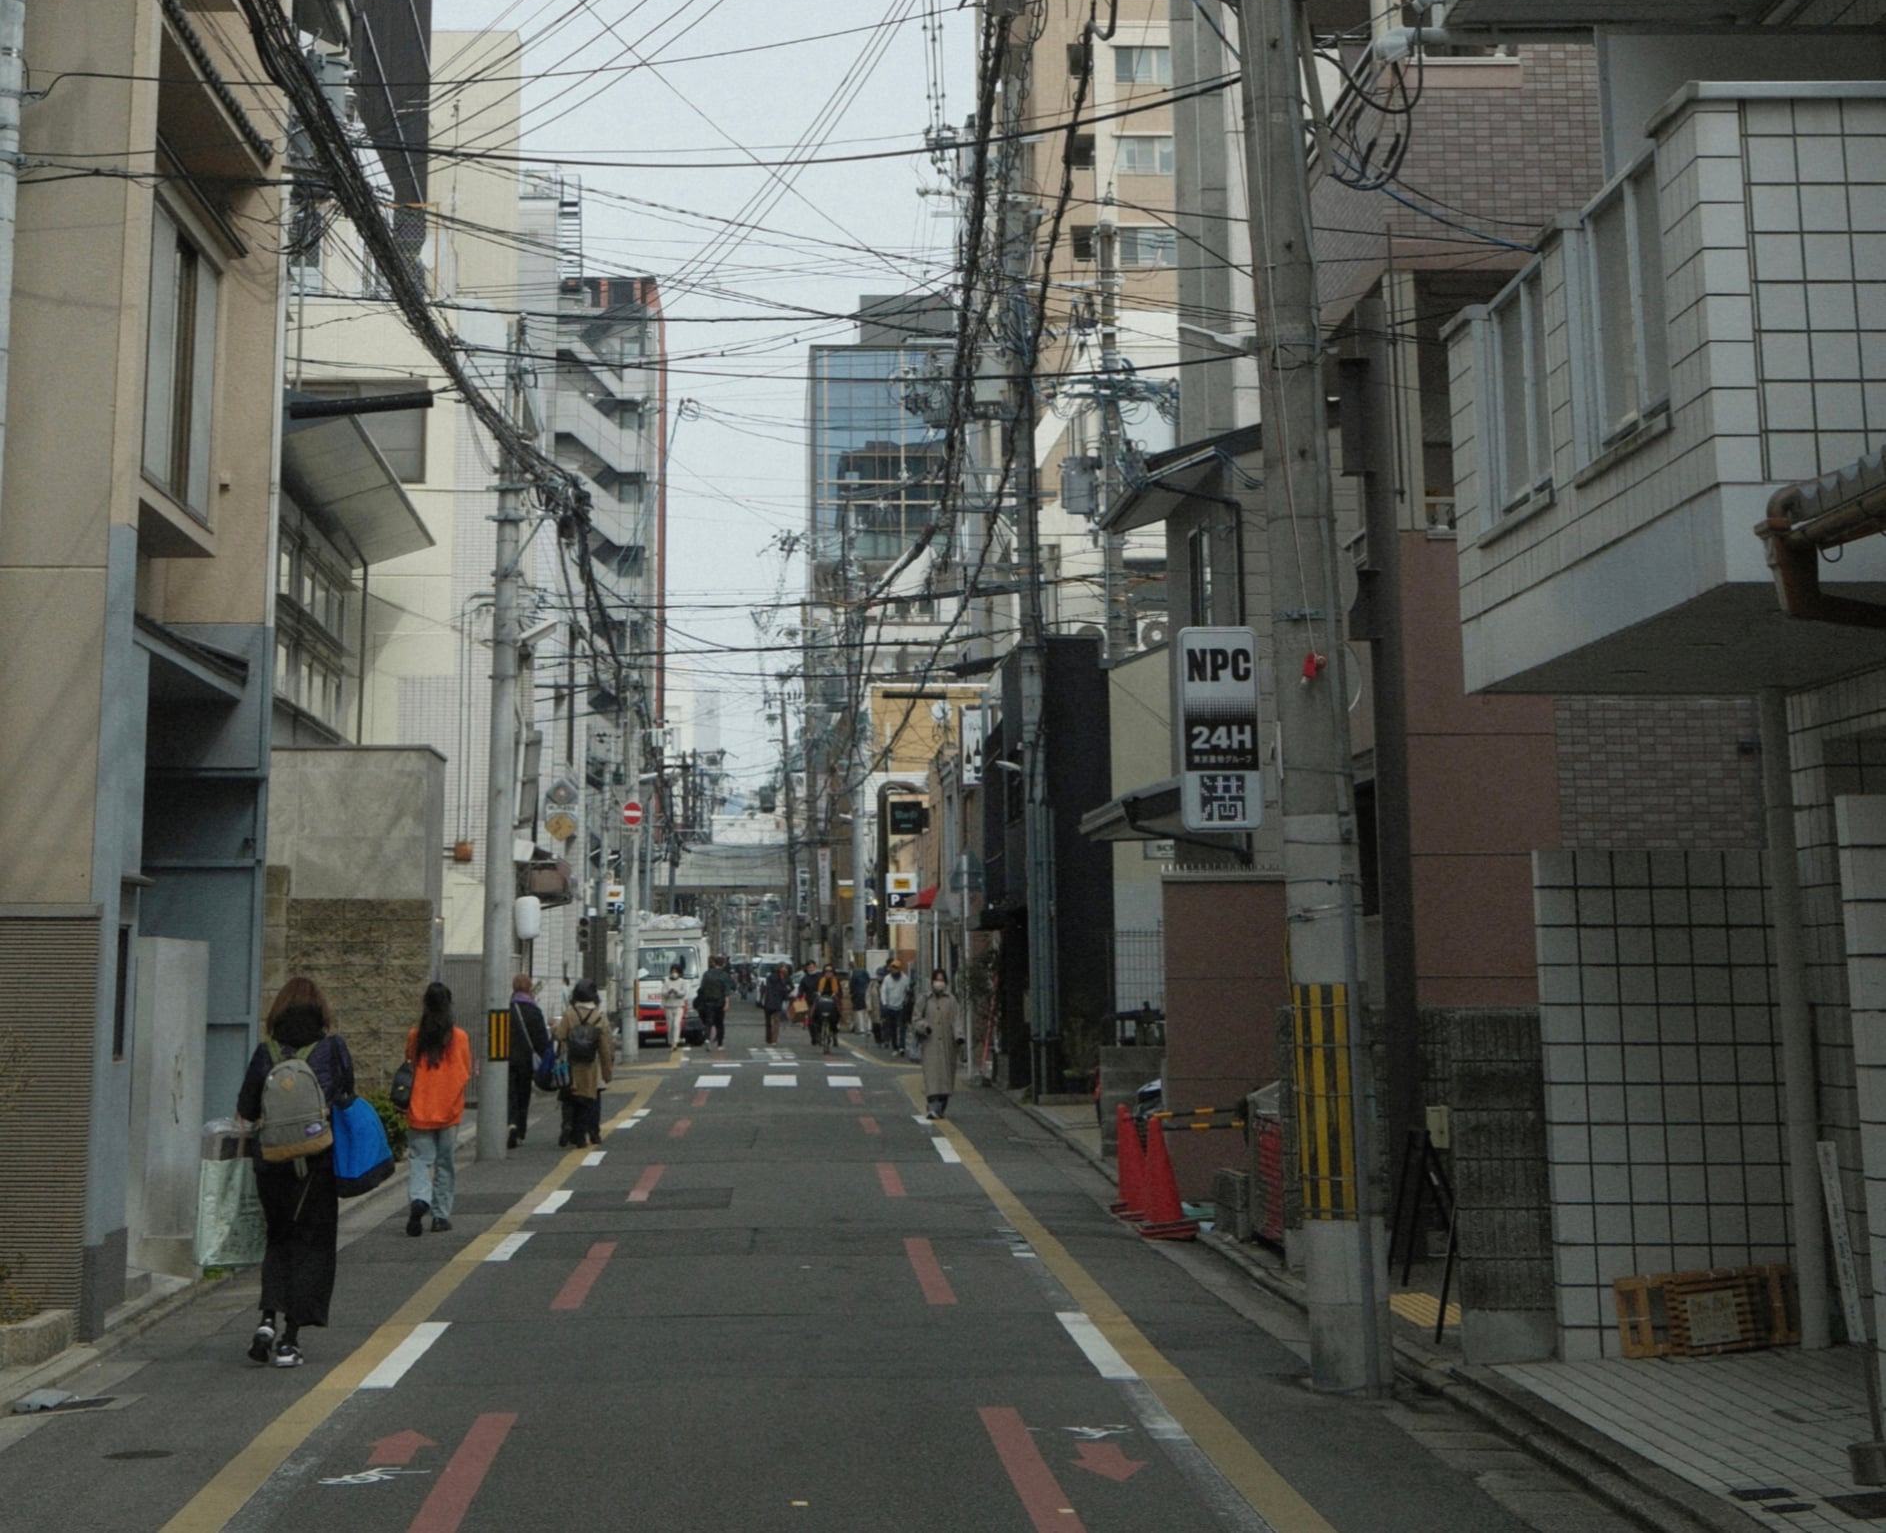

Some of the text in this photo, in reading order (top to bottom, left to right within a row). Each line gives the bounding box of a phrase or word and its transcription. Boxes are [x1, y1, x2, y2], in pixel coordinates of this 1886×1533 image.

[1187, 648, 1251, 682] NPC
[1192, 725, 1252, 749] 24H
[1200, 775, 1245, 821] 満
[891, 894, 900, 906] P
